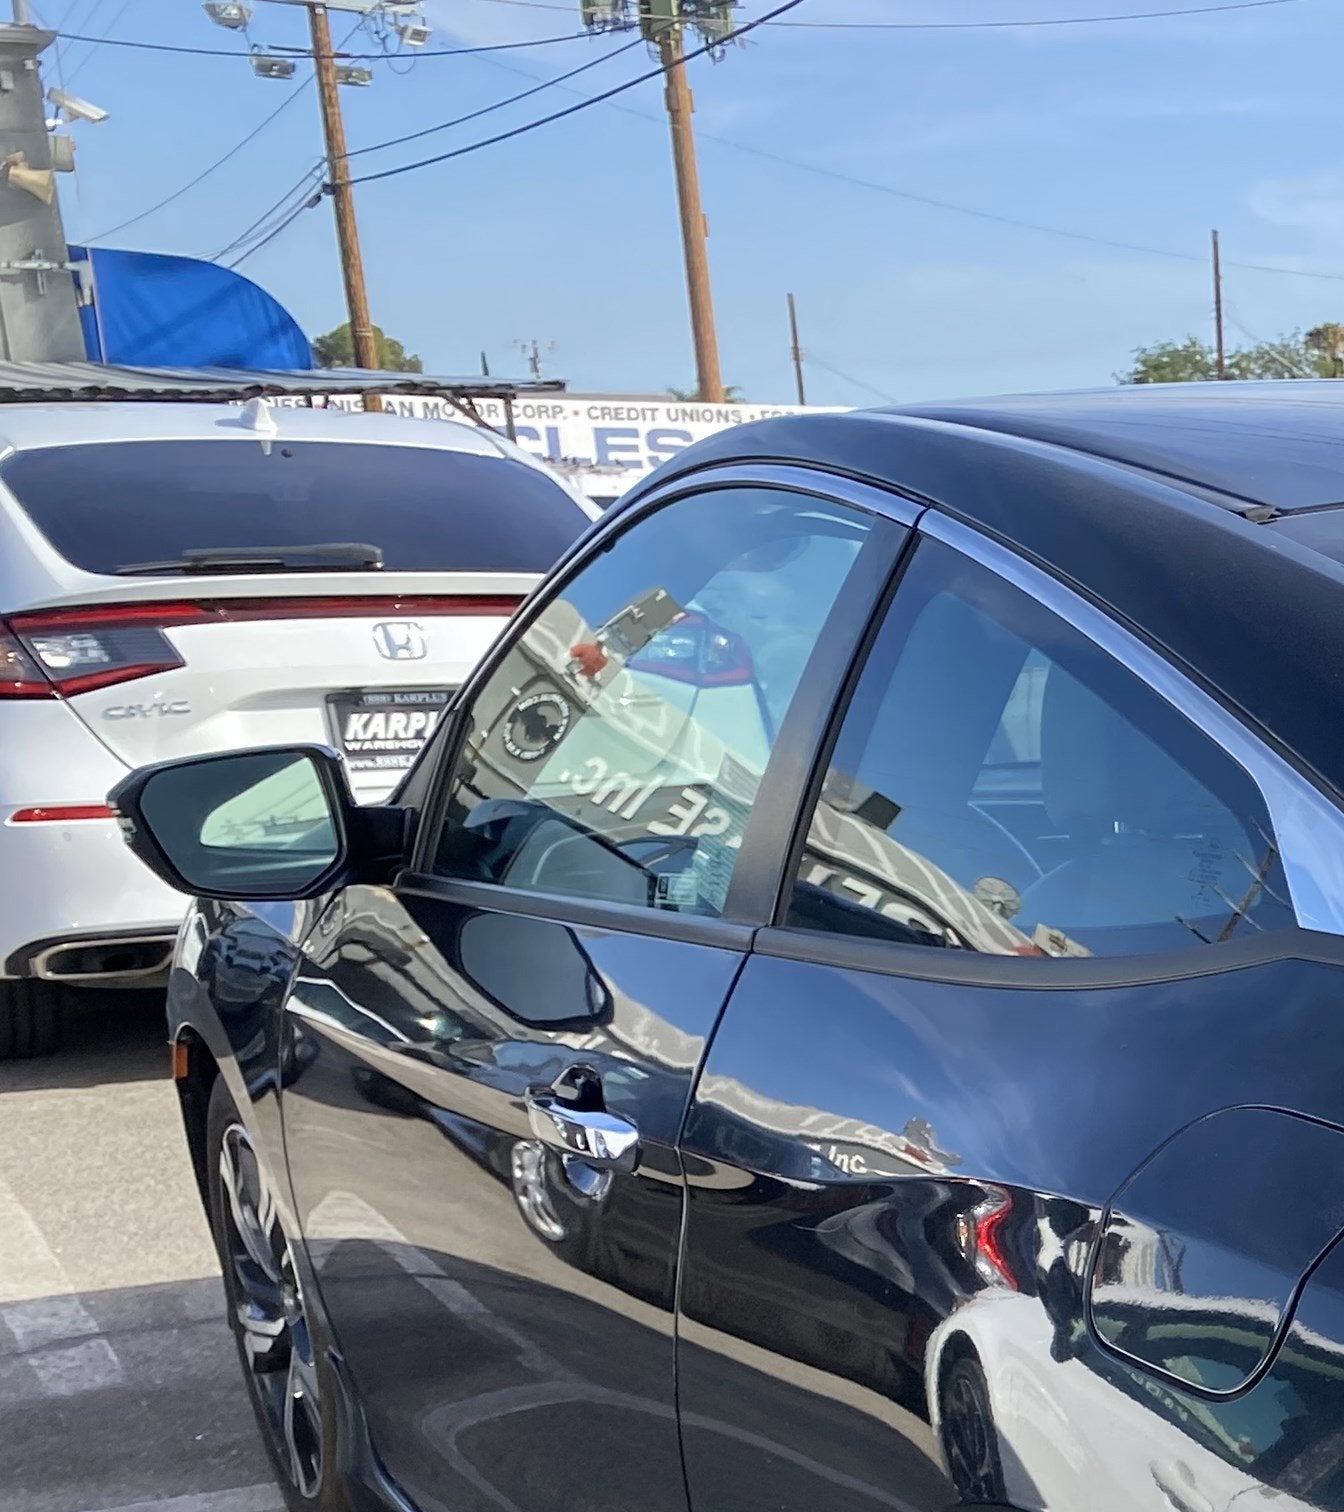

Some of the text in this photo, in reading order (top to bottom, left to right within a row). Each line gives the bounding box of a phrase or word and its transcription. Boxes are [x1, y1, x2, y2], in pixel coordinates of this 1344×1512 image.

[331, 400, 414, 417] NISAN
[587, 405, 659, 422] CREDIT
[666, 407, 742, 424] UNIONS
